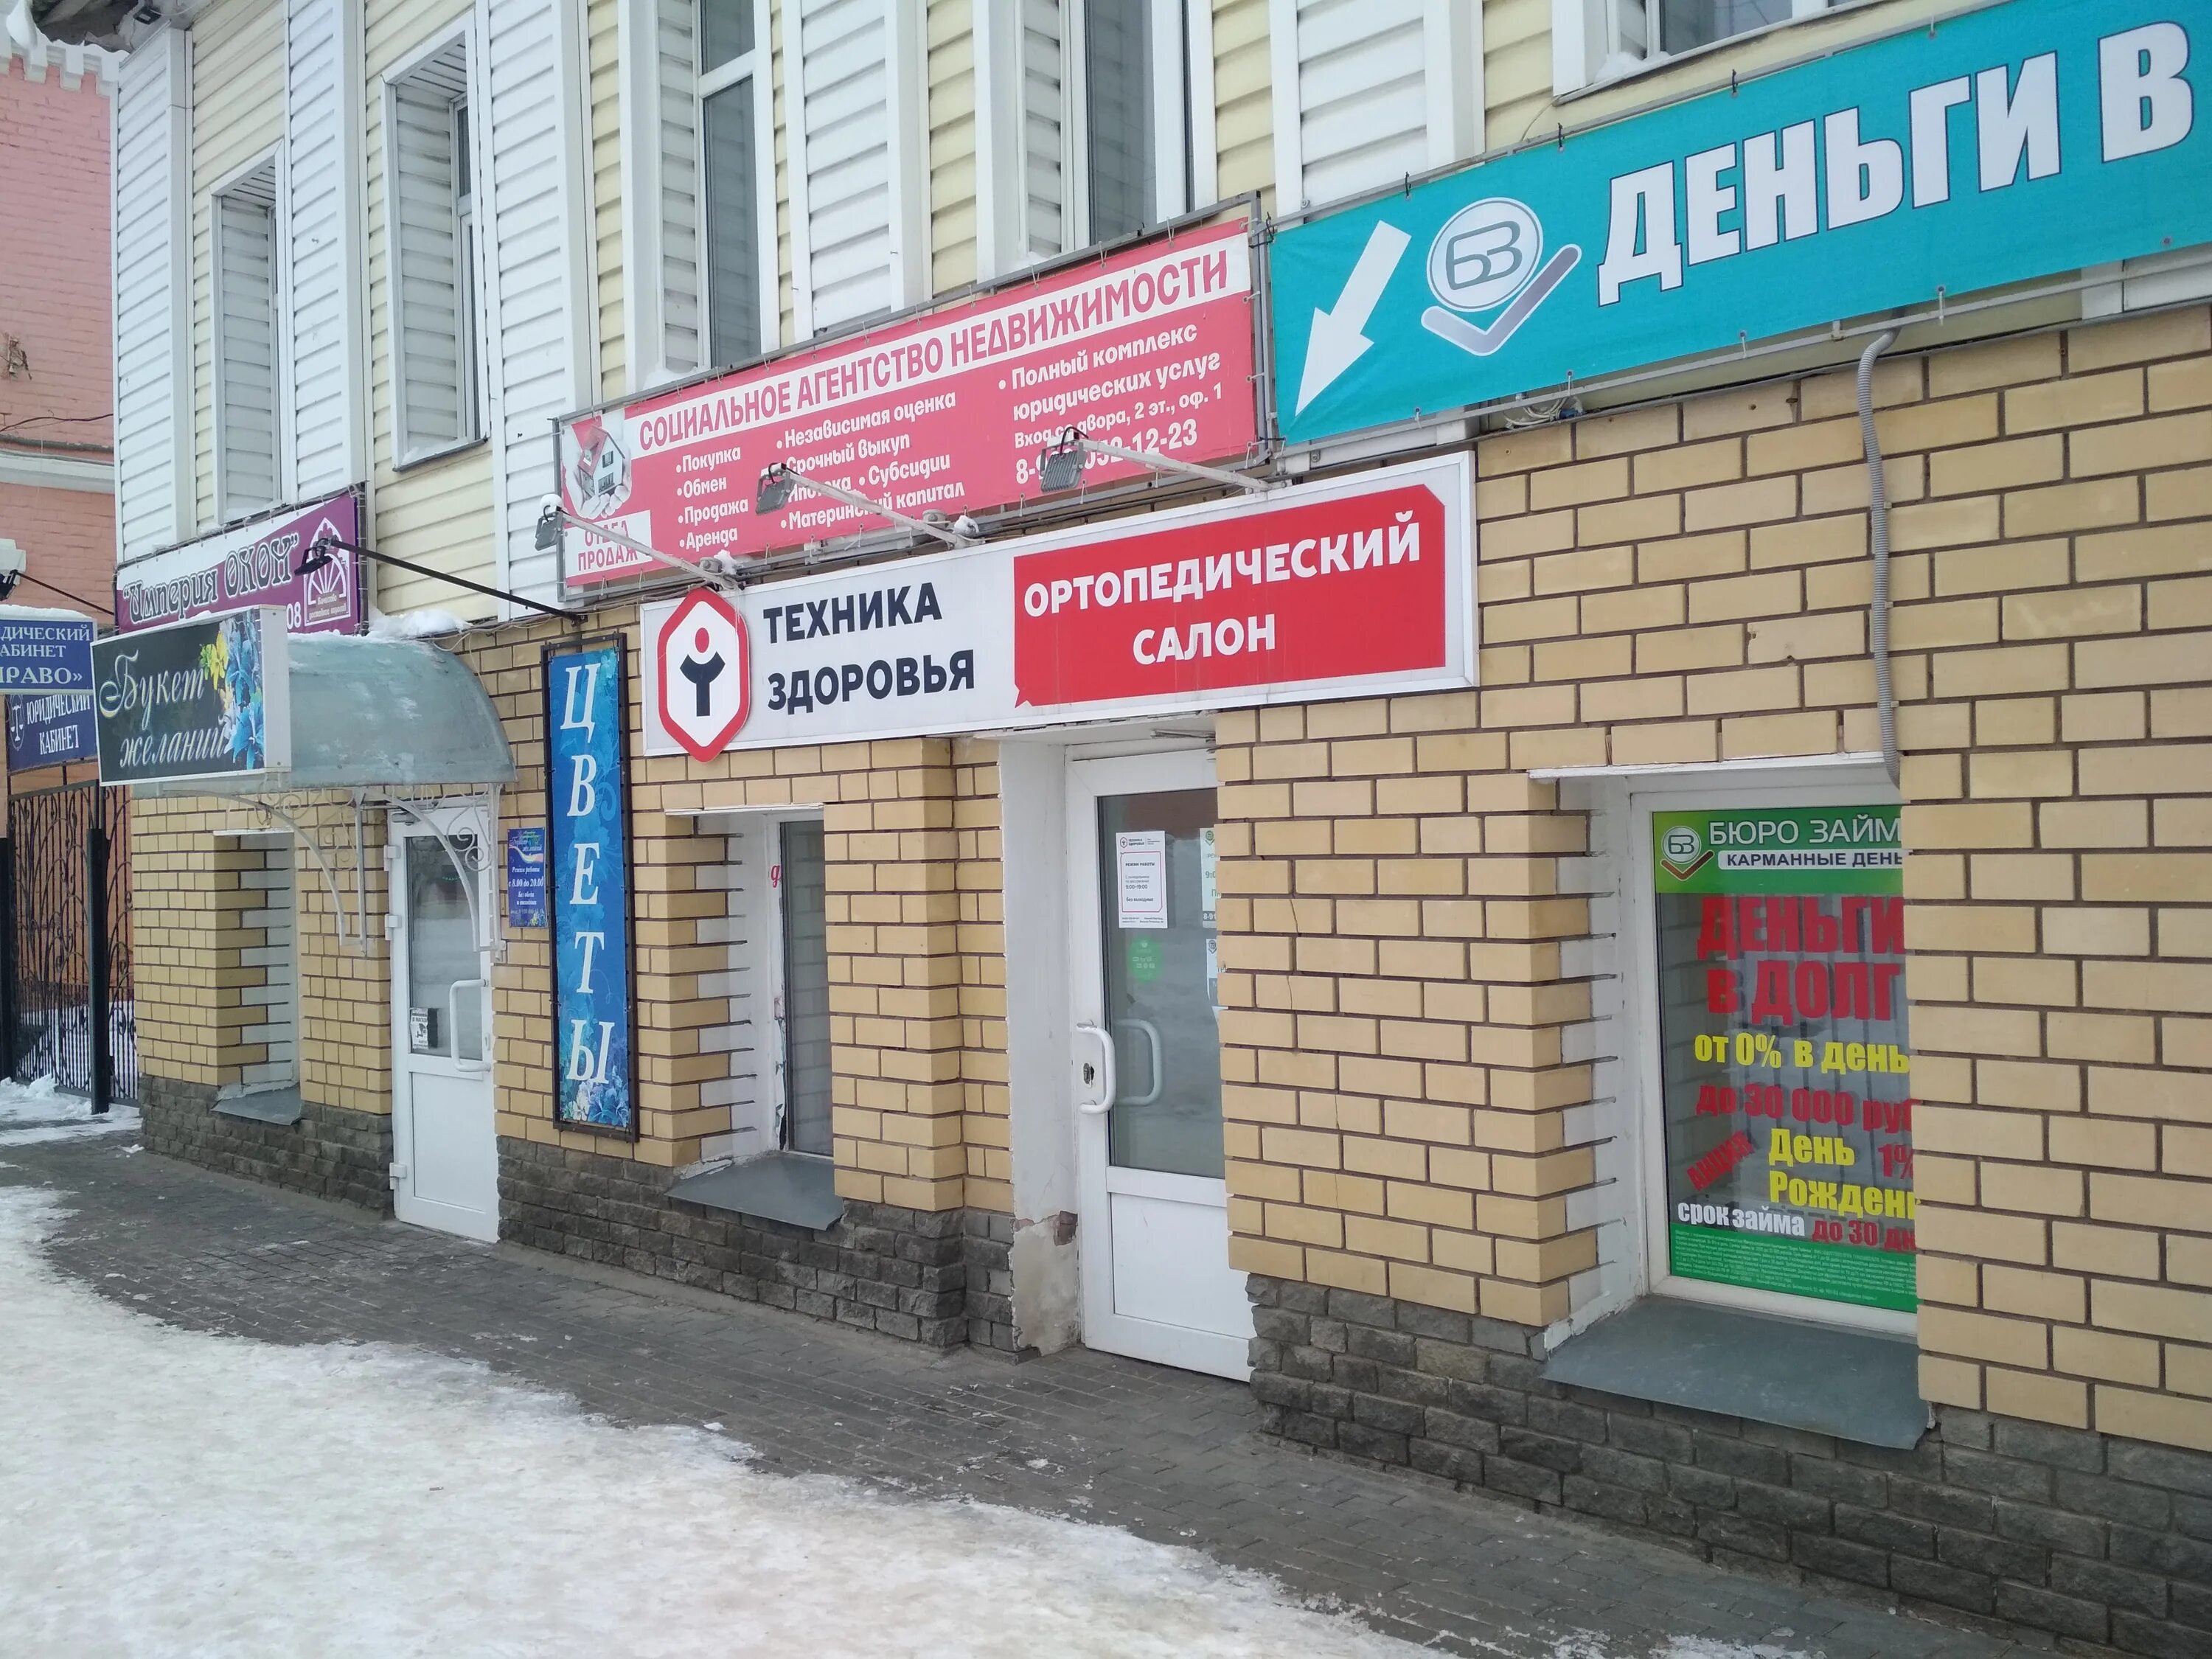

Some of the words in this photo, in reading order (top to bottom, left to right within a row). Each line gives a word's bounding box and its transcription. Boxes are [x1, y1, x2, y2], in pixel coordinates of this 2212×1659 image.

[1598, 49, 2062, 307] ДЕНЬГИ
[2098, 21, 2194, 163] В
[639, 383, 791, 451] СОЦИАЛЬНОЕ
[797, 336, 944, 410] АГЕНТСТВО
[950, 249, 1228, 368] НЕДВИЖИМОСТИ
[1012, 351, 1088, 390] Полный
[1093, 324, 1197, 368] комплекс
[1014, 378, 1151, 422] юридических
[1157, 353, 1221, 387] услуг
[1134, 402, 1144, 419] 2
[1179, 390, 1208, 410] оф.
[1213, 382, 1222, 400] 1
[785, 411, 890, 448] Независимая
[894, 392, 956, 422] оценка
[682, 447, 741, 474] Покупка
[786, 443, 855, 476] Срочный
[858, 434, 911, 459] выкуп
[869, 454, 950, 487] Субсидии
[683, 476, 727, 498] Обмен
[897, 481, 965, 509] капитал
[684, 498, 749, 527] Продажа
[686, 527, 738, 552] Аренда
[1024, 509, 1422, 618] ОРТОПЕДИЧЕСКИЙ
[763, 582, 942, 644] ТЕХНИКА
[1132, 612, 1276, 665] САЛОН
[99, 649, 205, 731] Букет
[767, 648, 975, 715] ЗДОРОВЬЯ
[39, 725, 80, 756] КАБИНЕТ
[119, 714, 226, 768] желаний
[1708, 820, 1799, 846] БЮРО
[560, 662, 615, 1085] ЦВЕТЫ
[1727, 852, 1846, 866] КАРМАННЫЕ
[1697, 895, 1906, 961] ДЕНЬГИ
[1750, 959, 1900, 1026] ДОЛГ
[1736, 1032, 1782, 1068] 0%
[1820, 1040, 1910, 1074] день
[1696, 1084, 1736, 1118] до
[1744, 1083, 1784, 1119] 30
[1792, 1088, 1854, 1125] 000
[1686, 1130, 1755, 1192] АКЦИЯ
[1769, 1127, 1855, 1167] День
[1677, 1201, 1730, 1227] срок
[1732, 1205, 1805, 1236] займа
[1812, 1218, 1842, 1242] до
[1848, 1219, 1877, 1246] 30
